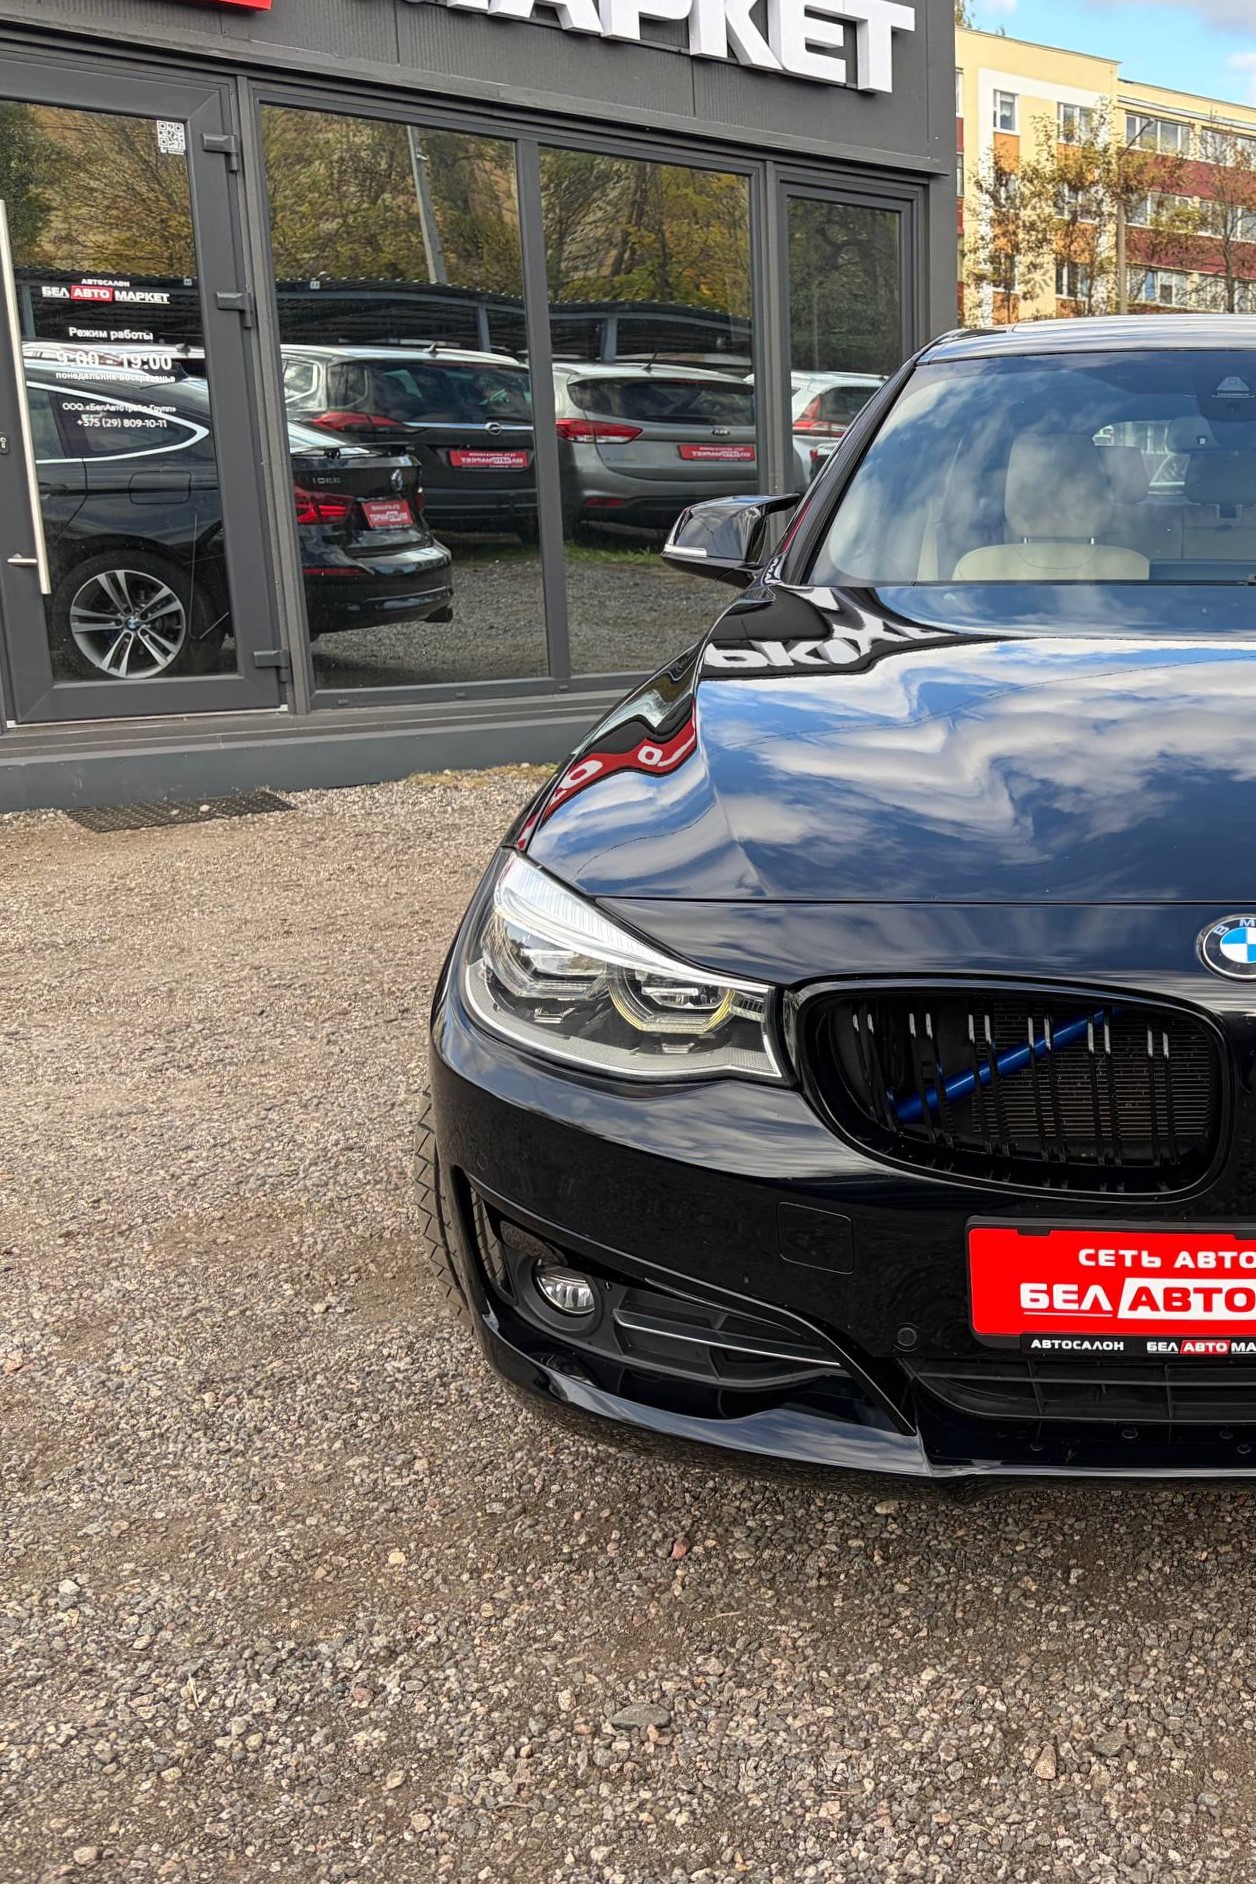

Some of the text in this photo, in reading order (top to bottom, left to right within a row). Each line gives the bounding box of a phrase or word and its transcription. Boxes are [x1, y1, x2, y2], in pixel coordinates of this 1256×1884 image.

[449, 0, 915, 94] КЕТ
[81, 278, 130, 287] АВТОСАЛОН
[41, 286, 170, 303] БЕЛ АВТО МАРКЕТ
[69, 327, 154, 341] Режим работы
[120, 354, 172, 370] 19:00
[62, 402, 84, 411] ООО
[77, 418, 167, 428] +375 (29) 809-10-11
[1078, 1248, 1162, 1268] СЕТЬ
[1019, 1282, 1113, 1311] БЕЛ
[1127, 1286, 1256, 1313] АВТО
[1030, 1338, 1124, 1351] АВТОСАЛОН
[1146, 1341, 1179, 1352] БЕЛ
[1183, 1341, 1228, 1352] АВТО
